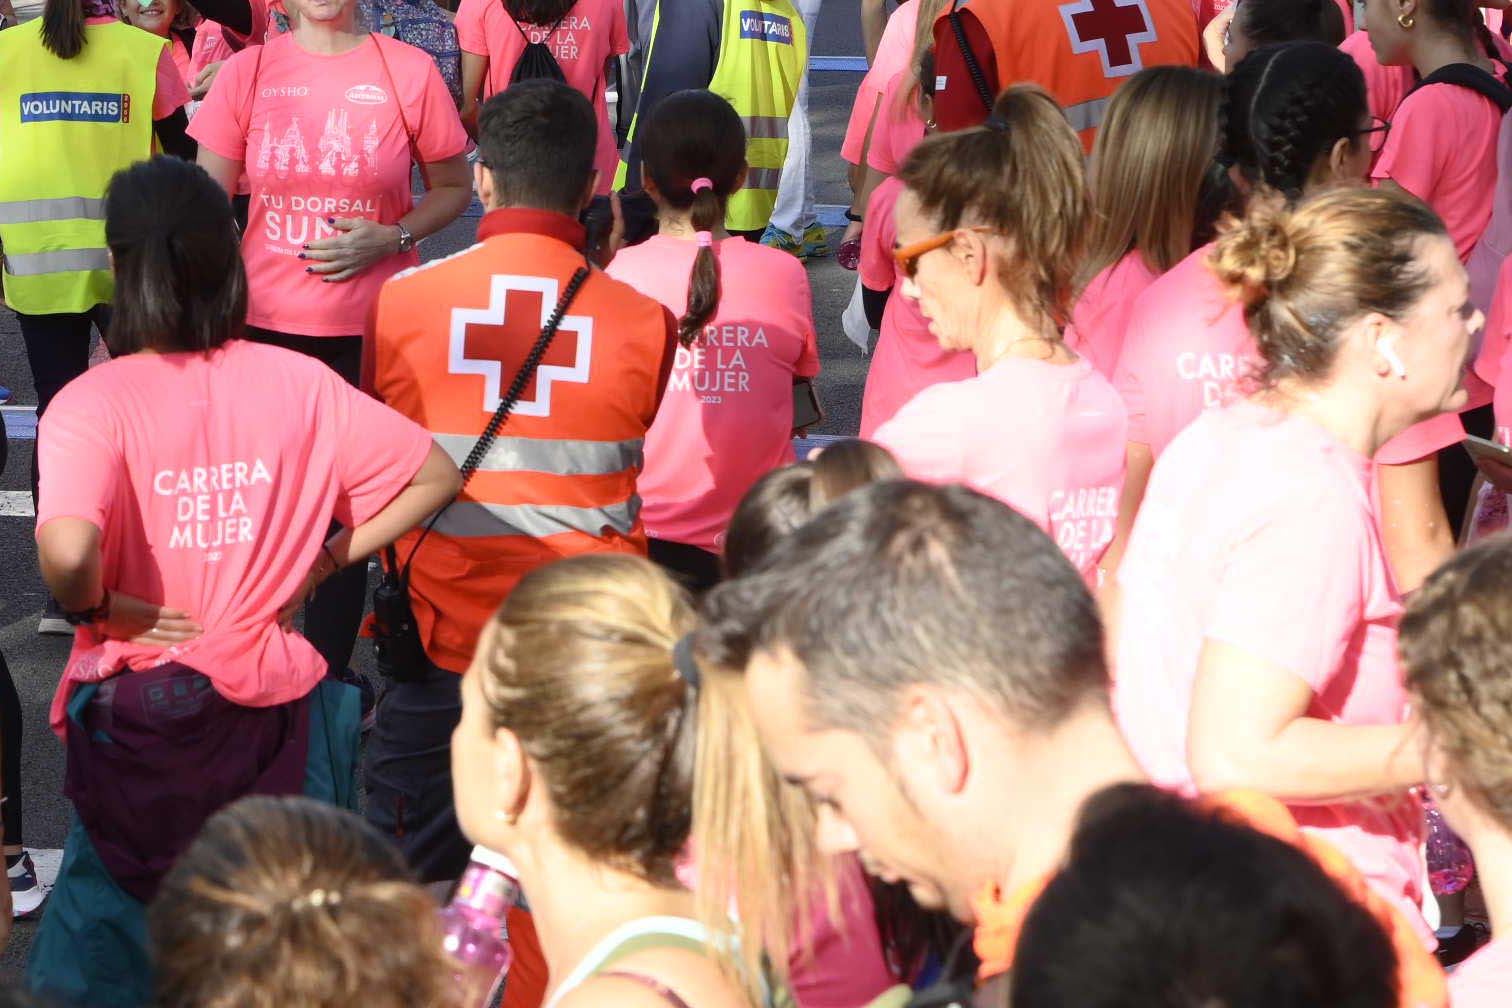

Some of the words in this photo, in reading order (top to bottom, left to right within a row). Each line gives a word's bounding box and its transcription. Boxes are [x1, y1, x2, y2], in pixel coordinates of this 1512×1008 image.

[556, 31, 577, 45] LA
[262, 86, 308, 99] OYSHO
[21, 100, 119, 116] VOLUNTARIS
[261, 192, 284, 209] TU
[291, 196, 376, 213] DORSAL
[265, 210, 343, 246] SUM
[675, 348, 706, 371] DE
[716, 348, 747, 371] LA
[668, 370, 751, 393] MUJER
[701, 395, 722, 405] 2023
[154, 458, 273, 496] CARRERA
[177, 495, 210, 522] DE
[216, 494, 247, 520] LA
[169, 518, 255, 550] MUJER
